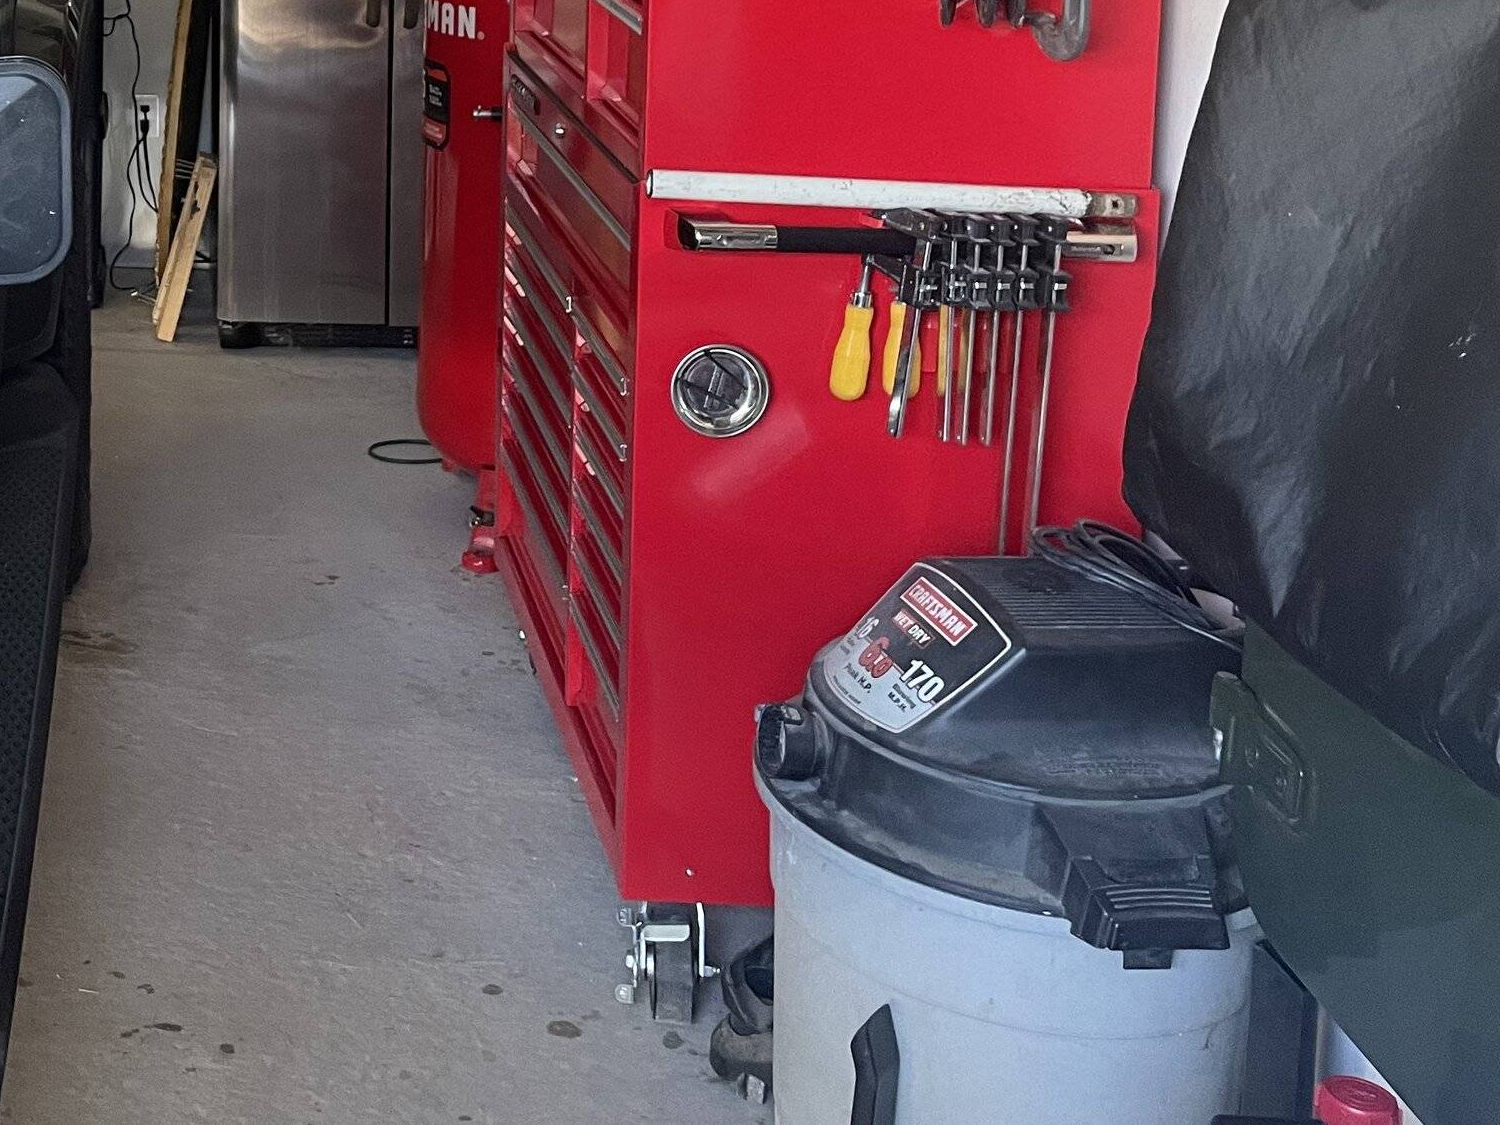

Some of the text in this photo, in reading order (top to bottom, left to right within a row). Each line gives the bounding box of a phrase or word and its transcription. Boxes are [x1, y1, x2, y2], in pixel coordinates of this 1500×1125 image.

[893, 610, 932, 644] WET DRY
[908, 584, 967, 636] CRAFTSMAN
[900, 659, 945, 704] 170
